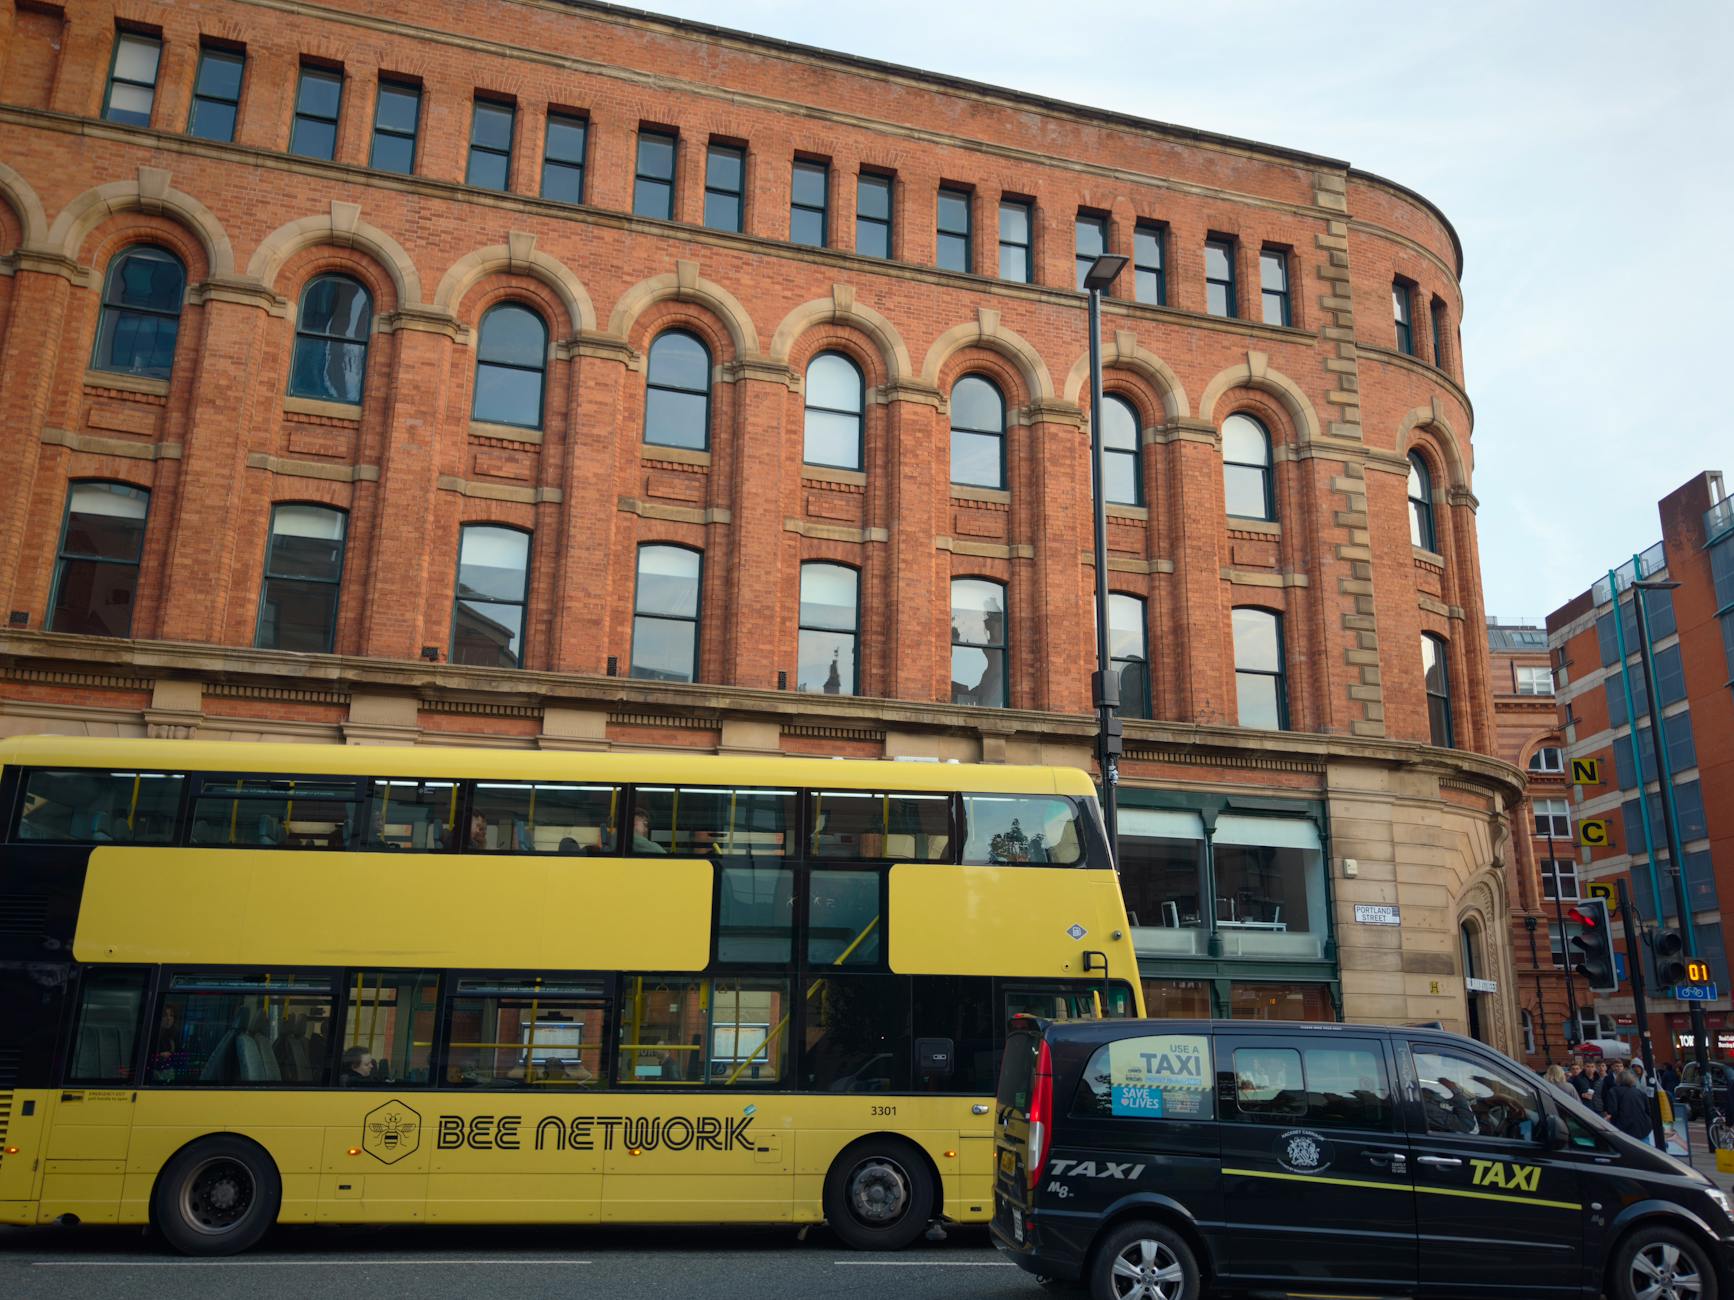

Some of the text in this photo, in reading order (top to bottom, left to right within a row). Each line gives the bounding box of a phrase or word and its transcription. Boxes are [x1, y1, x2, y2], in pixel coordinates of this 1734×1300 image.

[1356, 906, 1392, 915] PORTLAND
[1361, 914, 1387, 922] STREET
[1688, 964, 1708, 981] 01
[1170, 1044, 1200, 1054] USE A
[1140, 1052, 1202, 1076] TAXI
[1122, 1087, 1150, 1098] SAVE
[1129, 1098, 1160, 1109] LIVES
[871, 1106, 896, 1116] 3301
[437, 1115, 756, 1151] BEE NETWORK
[1050, 1159, 1147, 1180] TAXI
[1470, 1159, 1542, 1192] TAXI
